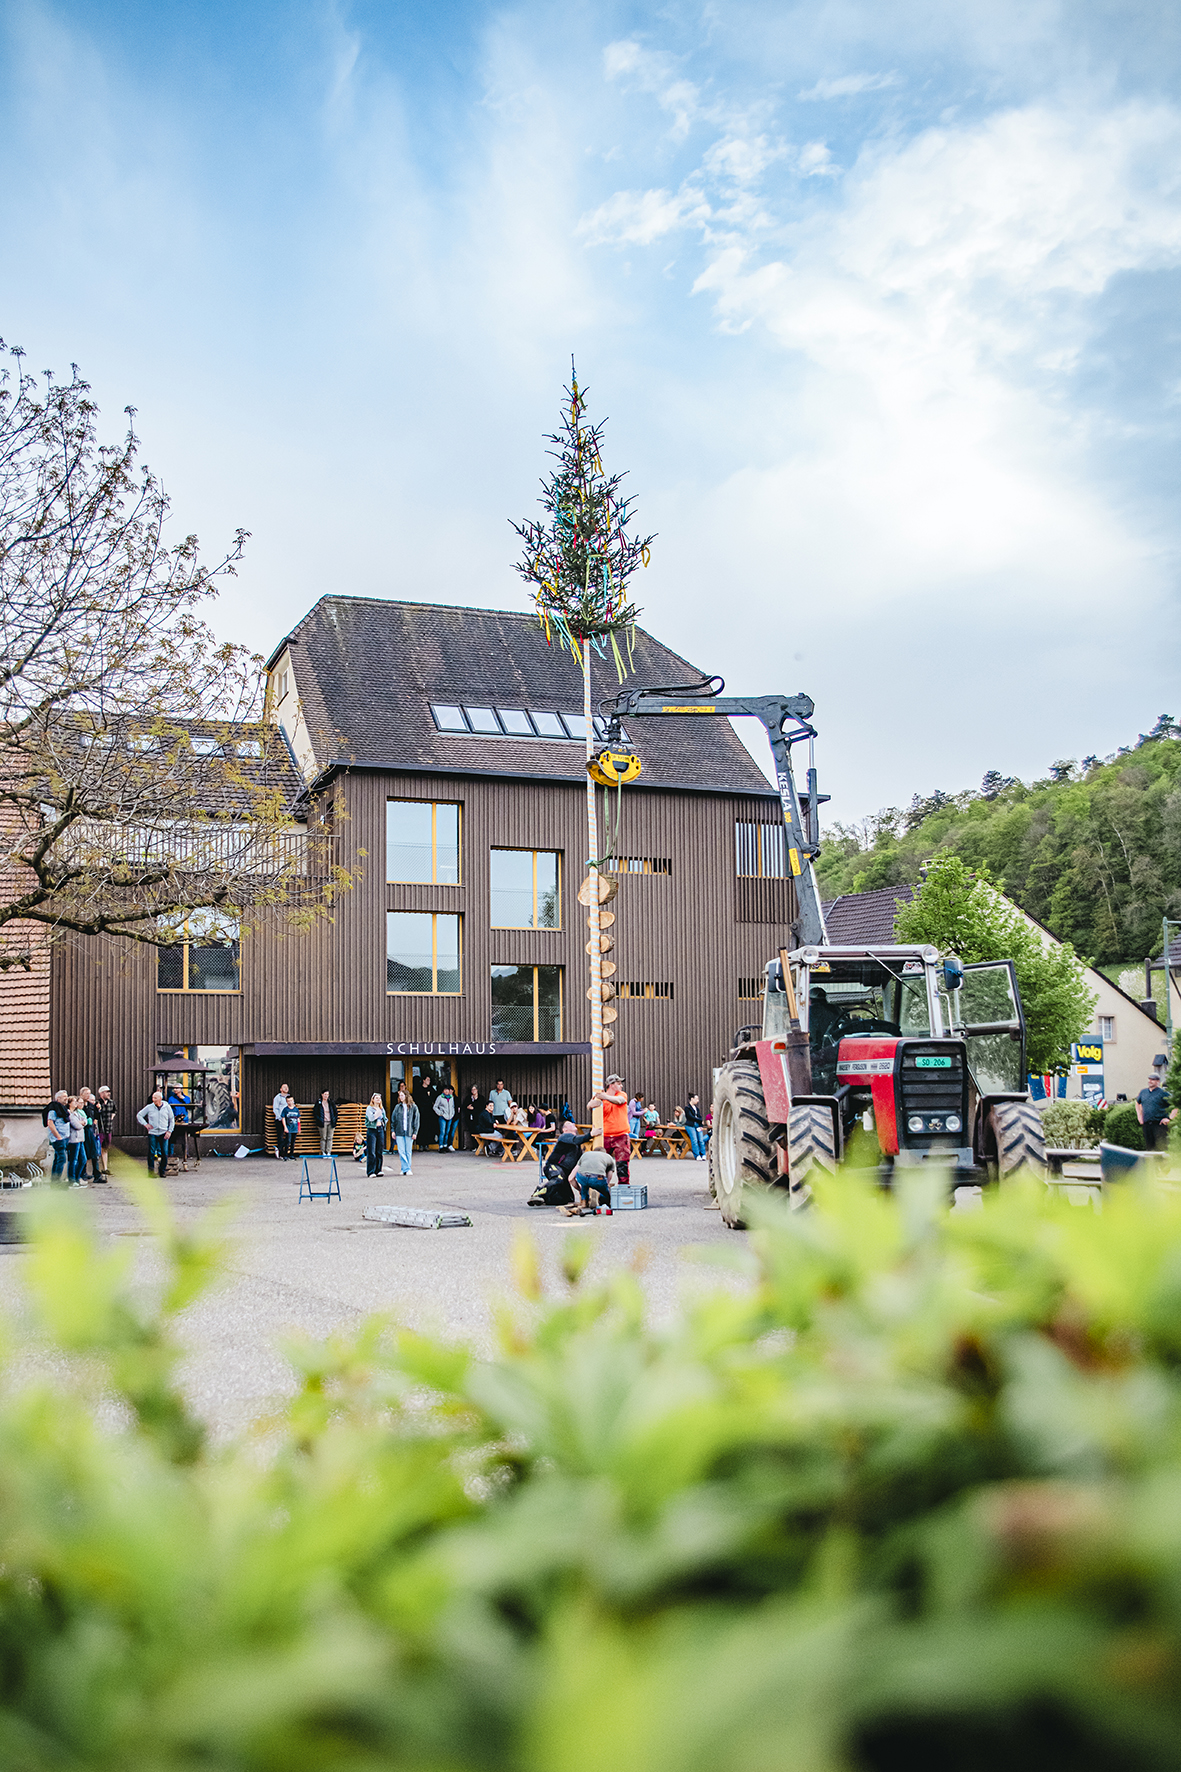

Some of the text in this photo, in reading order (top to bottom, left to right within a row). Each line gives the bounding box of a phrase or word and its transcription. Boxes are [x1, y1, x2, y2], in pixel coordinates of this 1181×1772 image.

[777, 772, 793, 811] KESLA
[386, 1043, 496, 1054] SCHULHAUS
[1076, 1045, 1102, 1061] Volg
[933, 1058, 946, 1067] 206
